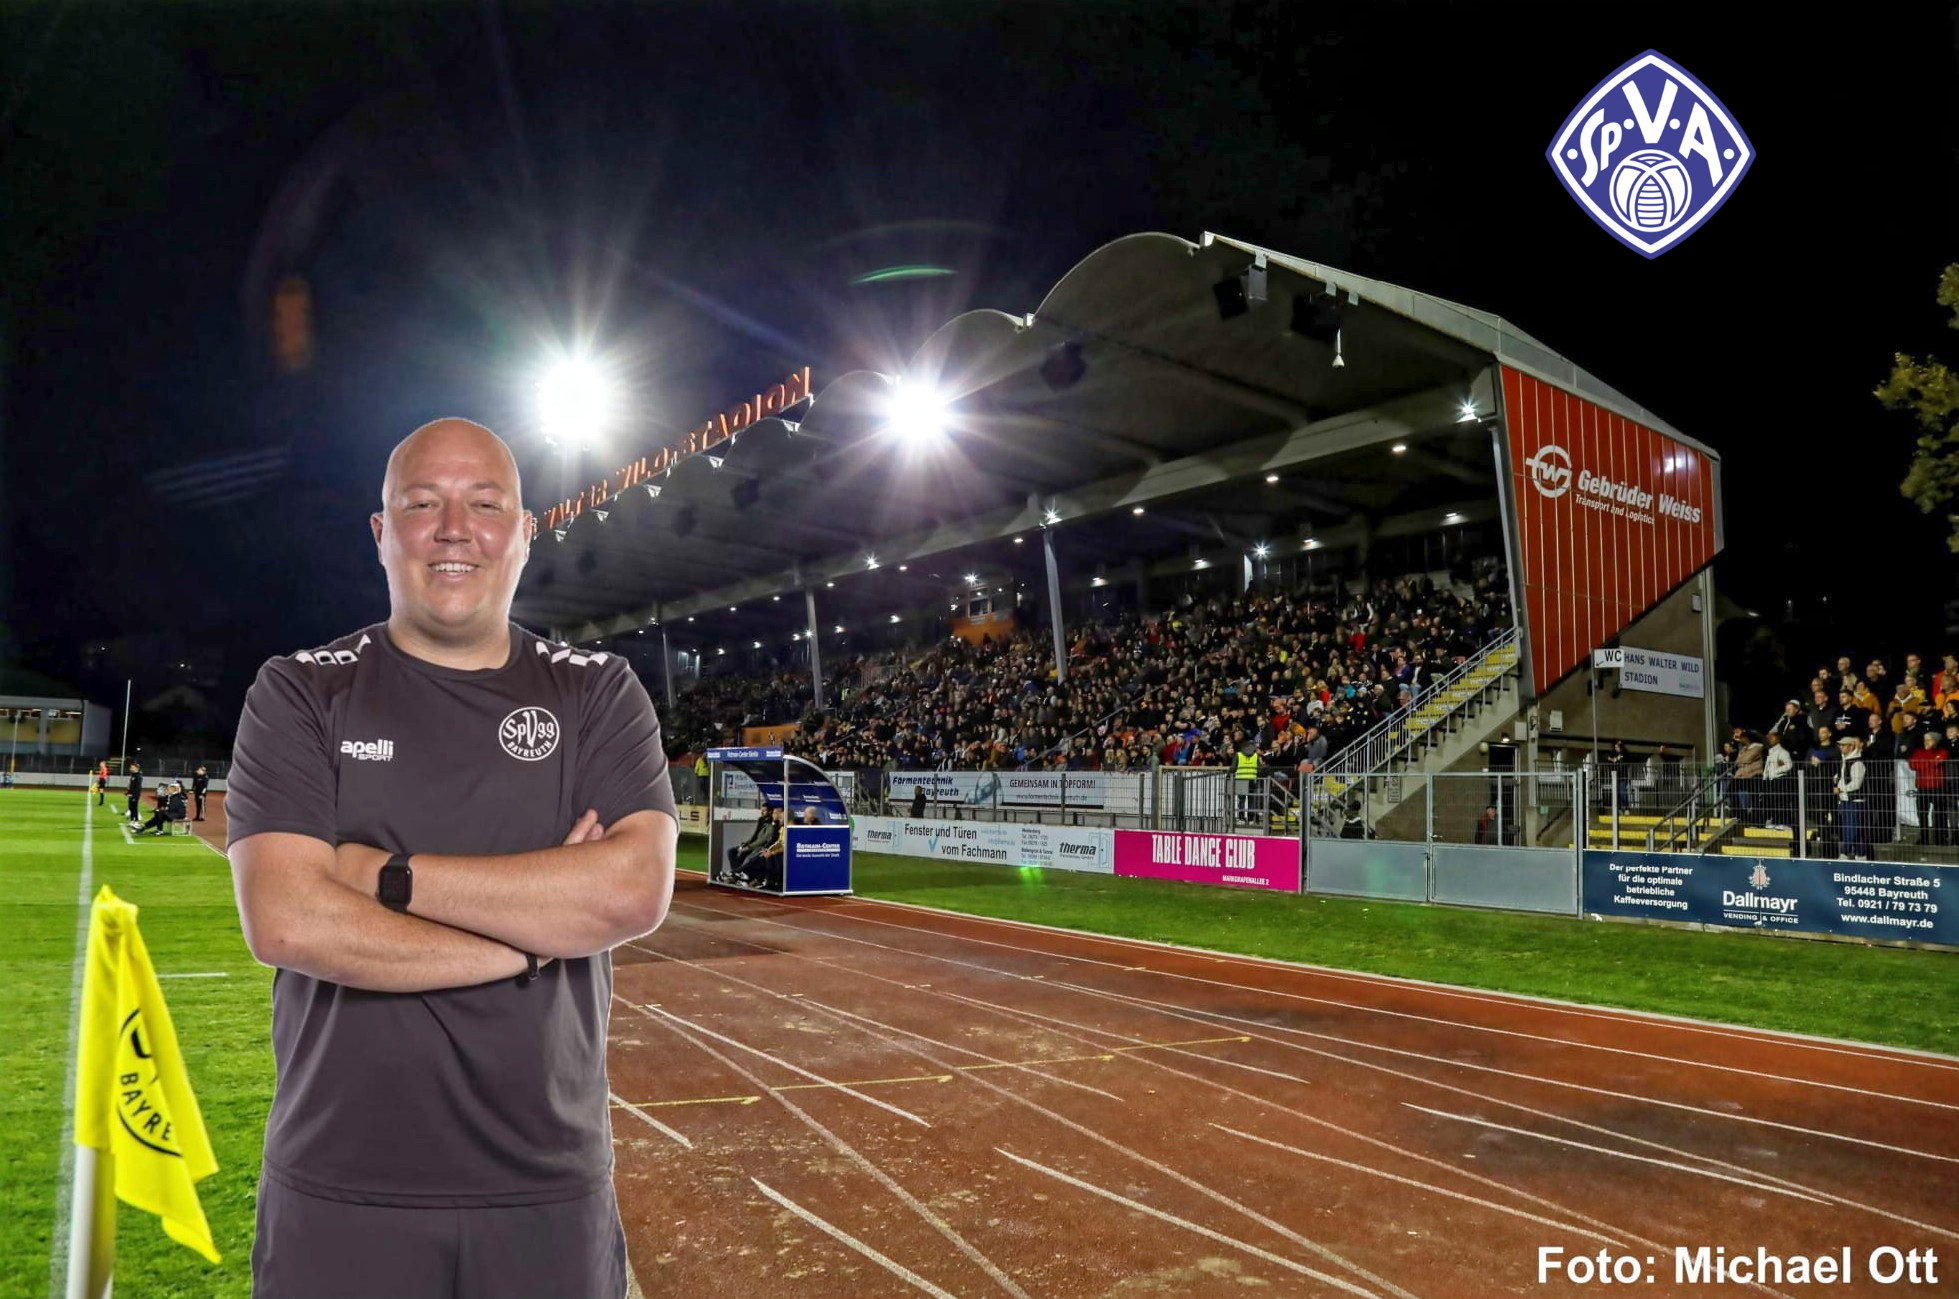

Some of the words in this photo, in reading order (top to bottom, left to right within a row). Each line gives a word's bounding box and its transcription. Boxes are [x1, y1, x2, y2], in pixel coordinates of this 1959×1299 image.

[1577, 469, 1653, 509] Gebrüder
[1658, 493, 1701, 523] Weiss
[1575, 493, 1610, 512] Transport
[1610, 505, 1625, 516] and
[1625, 509, 1655, 525] Logistics
[1604, 650, 1622, 662] WC
[1624, 653, 1645, 665] HANS
[1648, 656, 1678, 670] WALTER
[1681, 661, 1700, 673] WILD
[1624, 671, 1658, 685] STADION
[503, 710, 556, 748] SpVgg
[340, 738, 394, 758] apelli
[507, 740, 552, 757] BAYREUTH
[358, 753, 391, 761] SPORT
[892, 775, 953, 785] Formentechnik
[1009, 779, 1049, 788] GEMEINSAM
[1050, 779, 1058, 789] IN
[867, 829, 892, 840] therma
[904, 823, 933, 837] Fenster
[935, 825, 951, 838] und
[952, 825, 977, 840] Türen
[941, 845, 959, 855] vom
[961, 844, 1007, 860] Fachmann
[1059, 842, 1097, 855] therma
[1151, 834, 1182, 865] TABLE
[1184, 836, 1222, 868] DANCE
[1225, 838, 1256, 870] CLUB
[1609, 863, 1623, 871] Der
[1625, 864, 1660, 874] perfekte
[1661, 866, 1694, 876] Partner
[1618, 873, 1631, 883] für
[1632, 875, 1645, 884] die
[1647, 876, 1683, 886] optimale
[1833, 872, 1890, 885] Bindlacher
[1893, 876, 1930, 888] Straße
[1933, 878, 1941, 888] 5
[1626, 885, 1675, 897] betriebliche
[1844, 886, 1875, 897] 95448
[1878, 888, 1929, 900] Bayreuth
[1613, 895, 1688, 911] Kaffeeversorgung
[1722, 890, 1799, 913] Dallmayr
[1836, 897, 1856, 907] Tel.
[1857, 899, 1882, 909] 0921
[1885, 899, 1889, 909] /
[1891, 901, 1906, 911] 79
[1908, 902, 1921, 912] 73
[1924, 903, 1938, 913] 79
[1723, 912, 1758, 922] VENDING
[1770, 916, 1799, 924] OFFICE
[1841, 912, 1934, 928] www.dallmayr.de
